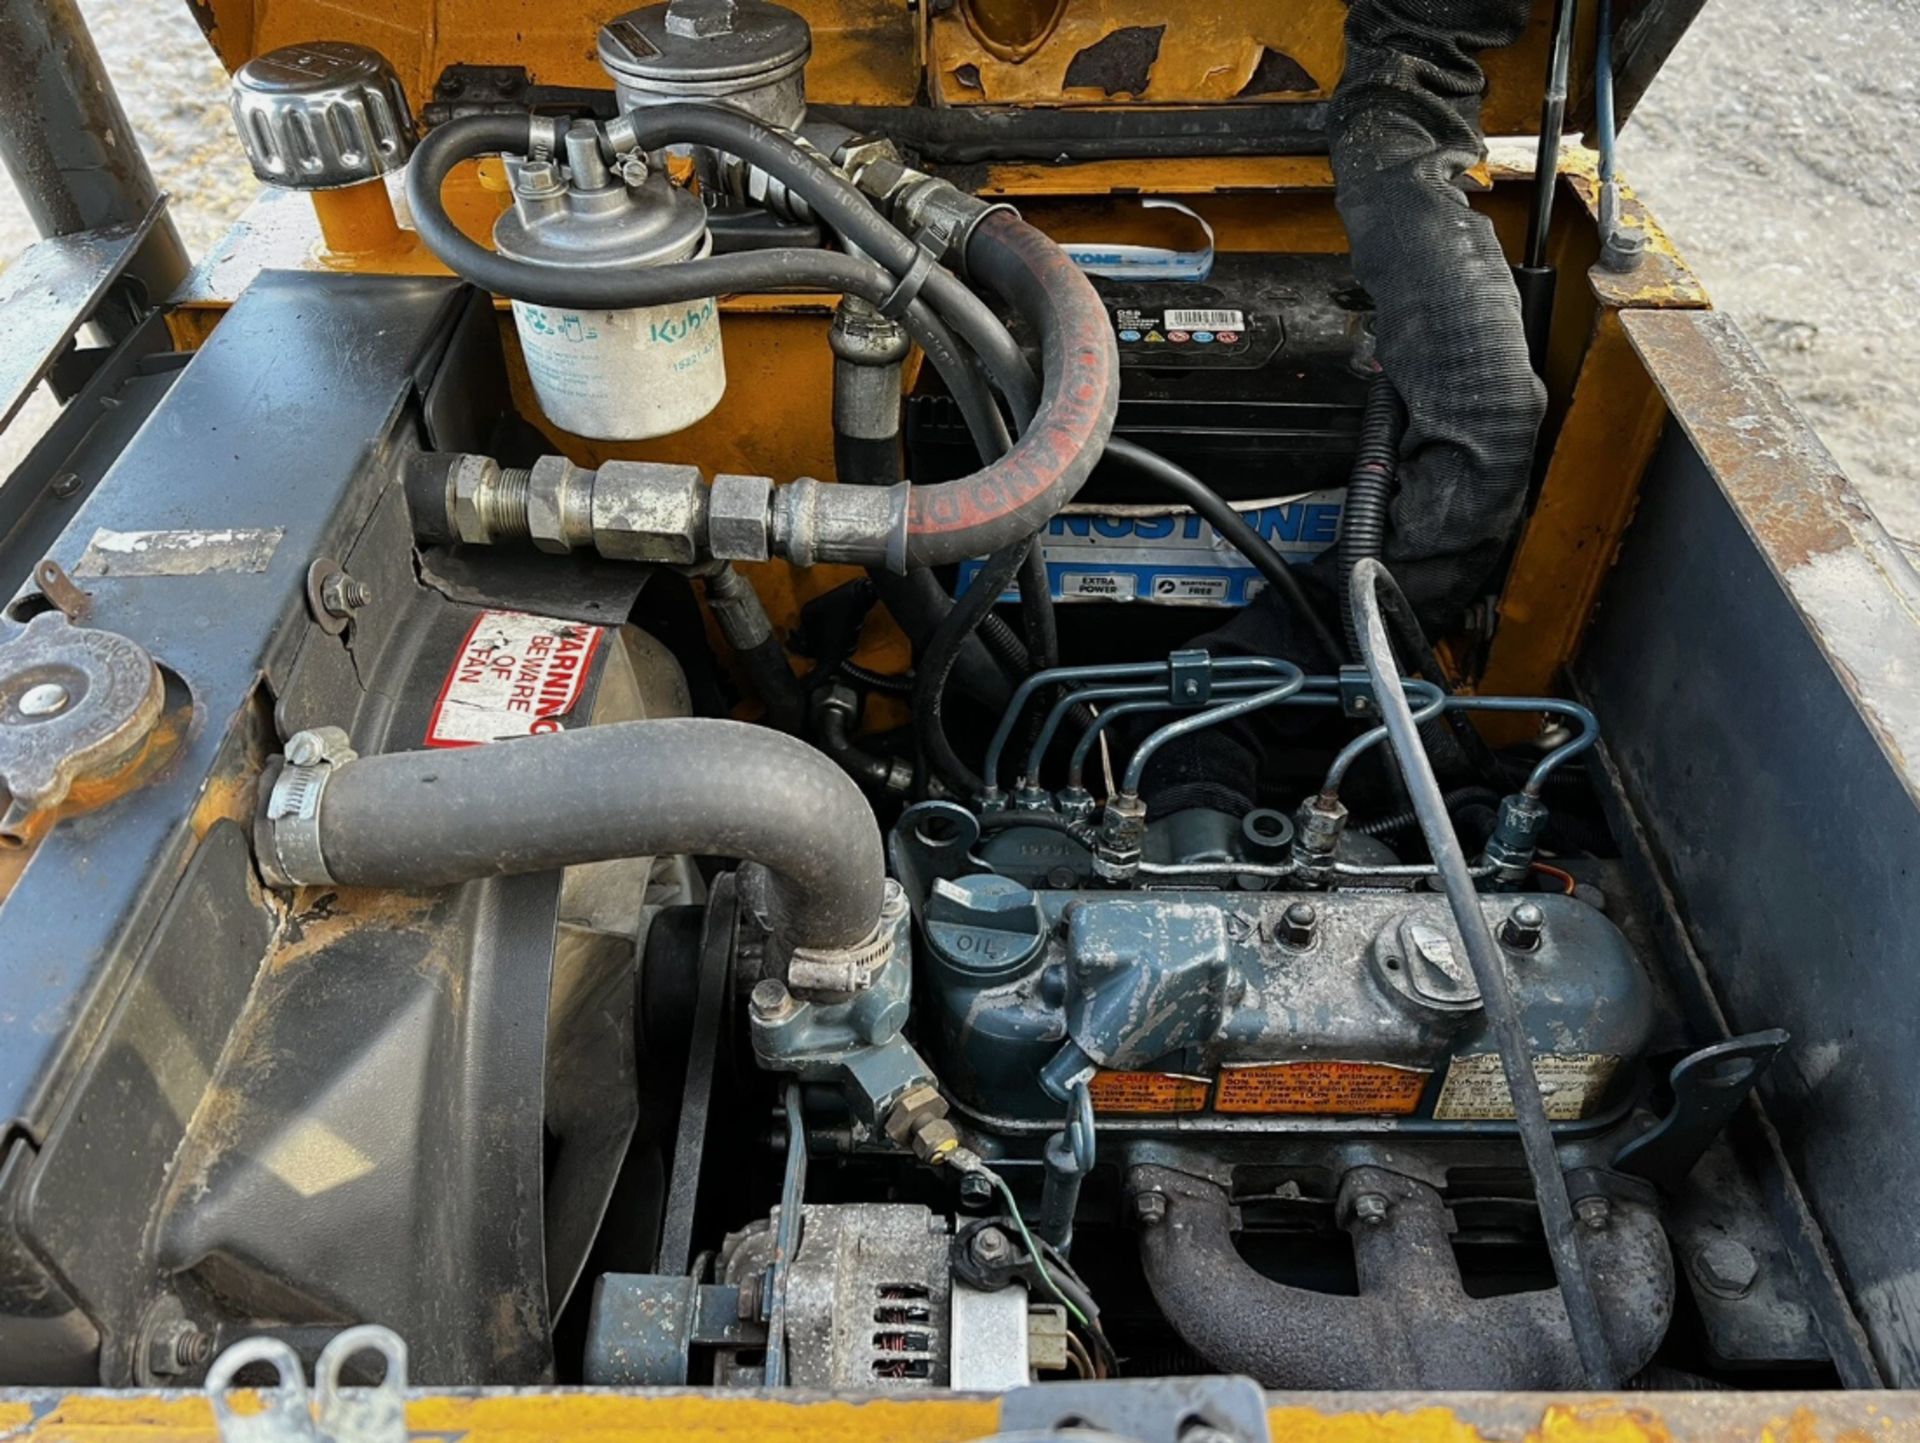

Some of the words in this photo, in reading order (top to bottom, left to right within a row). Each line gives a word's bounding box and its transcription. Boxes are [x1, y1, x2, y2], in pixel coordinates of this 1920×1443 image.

[787, 151, 827, 185] SAE
[1078, 585, 1117, 593] POWER
[1082, 577, 1115, 585] EXTRA
[458, 647, 492, 684] FAN
[490, 655, 516, 681] OF
[506, 635, 554, 713] BEWARE
[529, 623, 589, 735] WARNING
[956, 935, 994, 955] OIL
[1289, 1062, 1364, 1072] CAUTION
